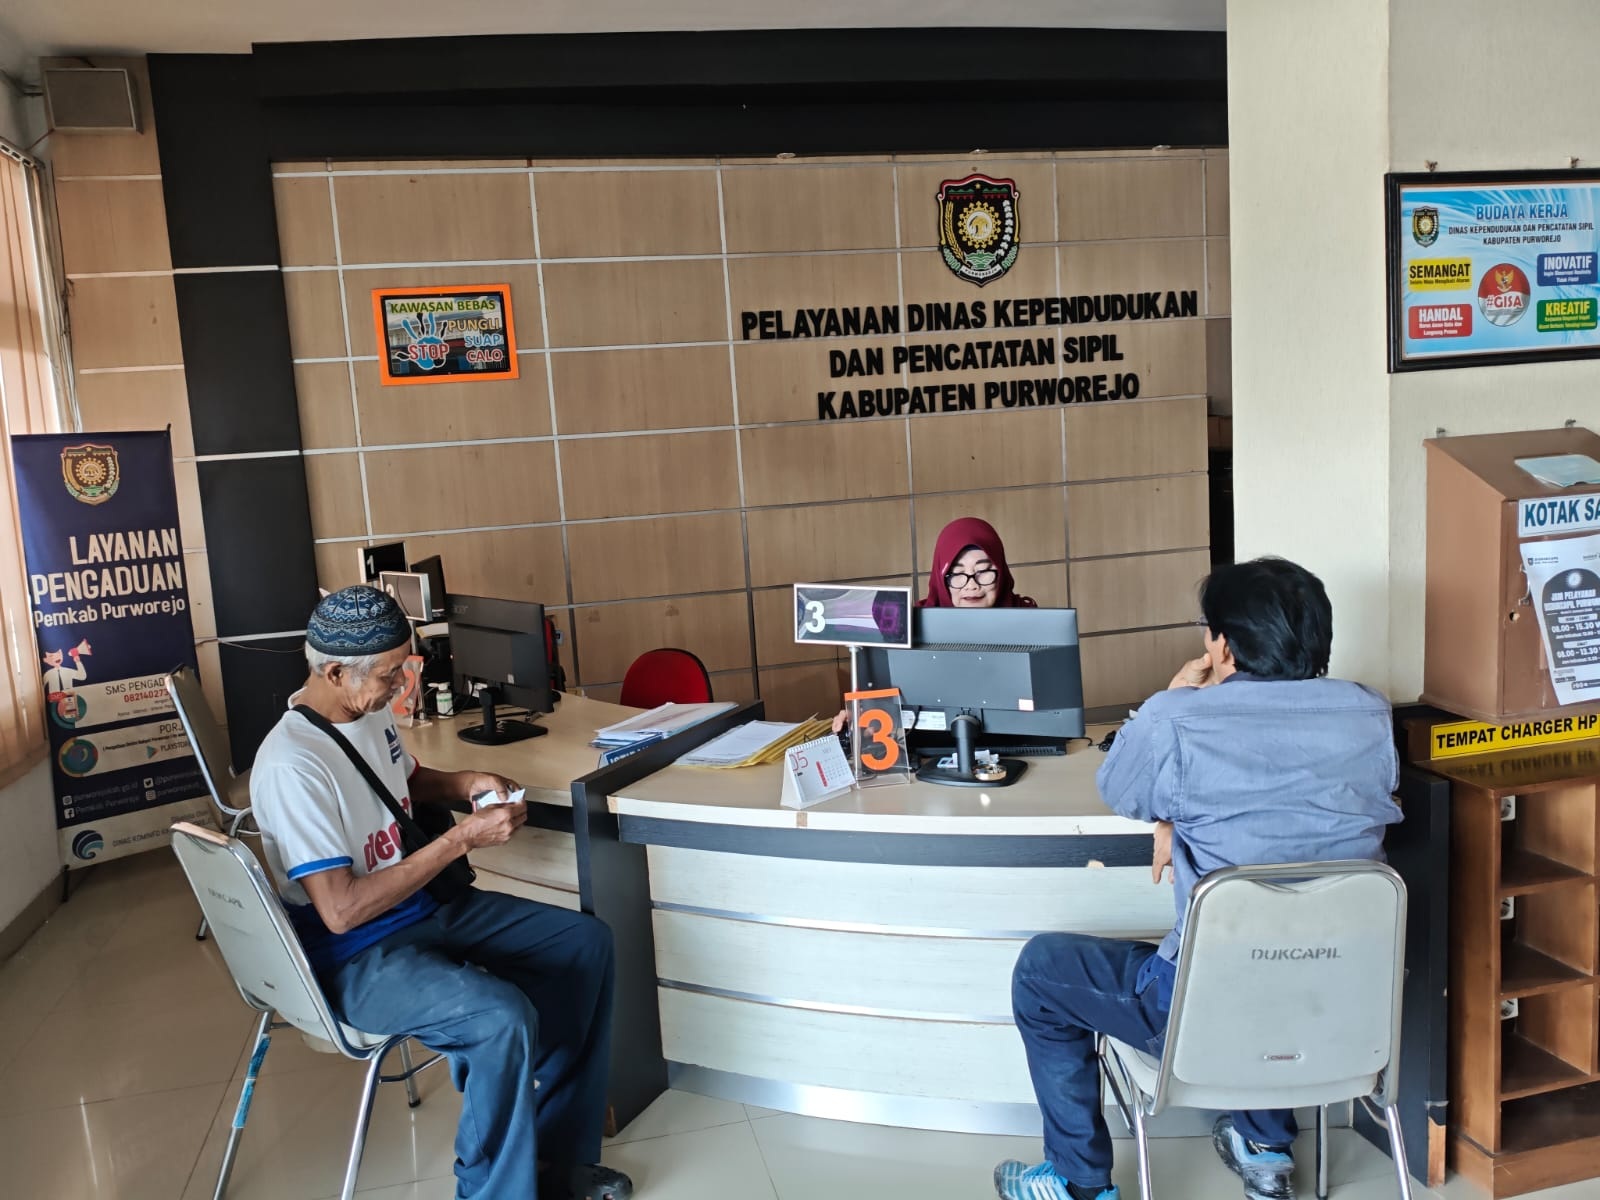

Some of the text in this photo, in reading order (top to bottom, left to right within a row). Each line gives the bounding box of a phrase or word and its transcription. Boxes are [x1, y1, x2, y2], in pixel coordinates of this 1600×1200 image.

[1476, 203, 1568, 220] BUDAYA KERJA
[1448, 222, 1594, 235] DINAS KEPENDUDUKAN DAN PENCATATAN SIPIL
[1483, 234, 1561, 245] KABUPATEN PURWOREJO
[1543, 256, 1592, 270] INOVATIF
[1409, 264, 1471, 279] SEMANGAT
[390, 299, 496, 314] KAWASAN BEBAS
[1487, 295, 1523, 308] #GISA
[1545, 301, 1590, 316] KREATIF
[742, 290, 1198, 340] PELAYANAN DINAS KEPENDUDUKAN
[1419, 307, 1463, 322] HANDAL
[448, 318, 499, 331] PUNGLI
[464, 333, 501, 347] SUAP
[408, 344, 449, 360] STOP
[466, 349, 503, 363] CALO
[830, 334, 1123, 378] DAN PENCATATAN SIPIL
[817, 373, 1139, 420] KABUPATEN PURWOREJO
[1524, 499, 1580, 527] KOTAK
[69, 528, 179, 565] LAYANAN
[366, 554, 375, 575] 1
[31, 561, 183, 605] PENGADUAN
[33, 595, 186, 628] Pemkab Purworejo
[805, 601, 826, 633] 3
[105, 683, 126, 696] SMS
[393, 669, 415, 715] 2
[858, 709, 899, 770] 3
[1436, 714, 1597, 749] TEMPAT CHARGER HP
[1251, 947, 1342, 960] DUKCAPIL
